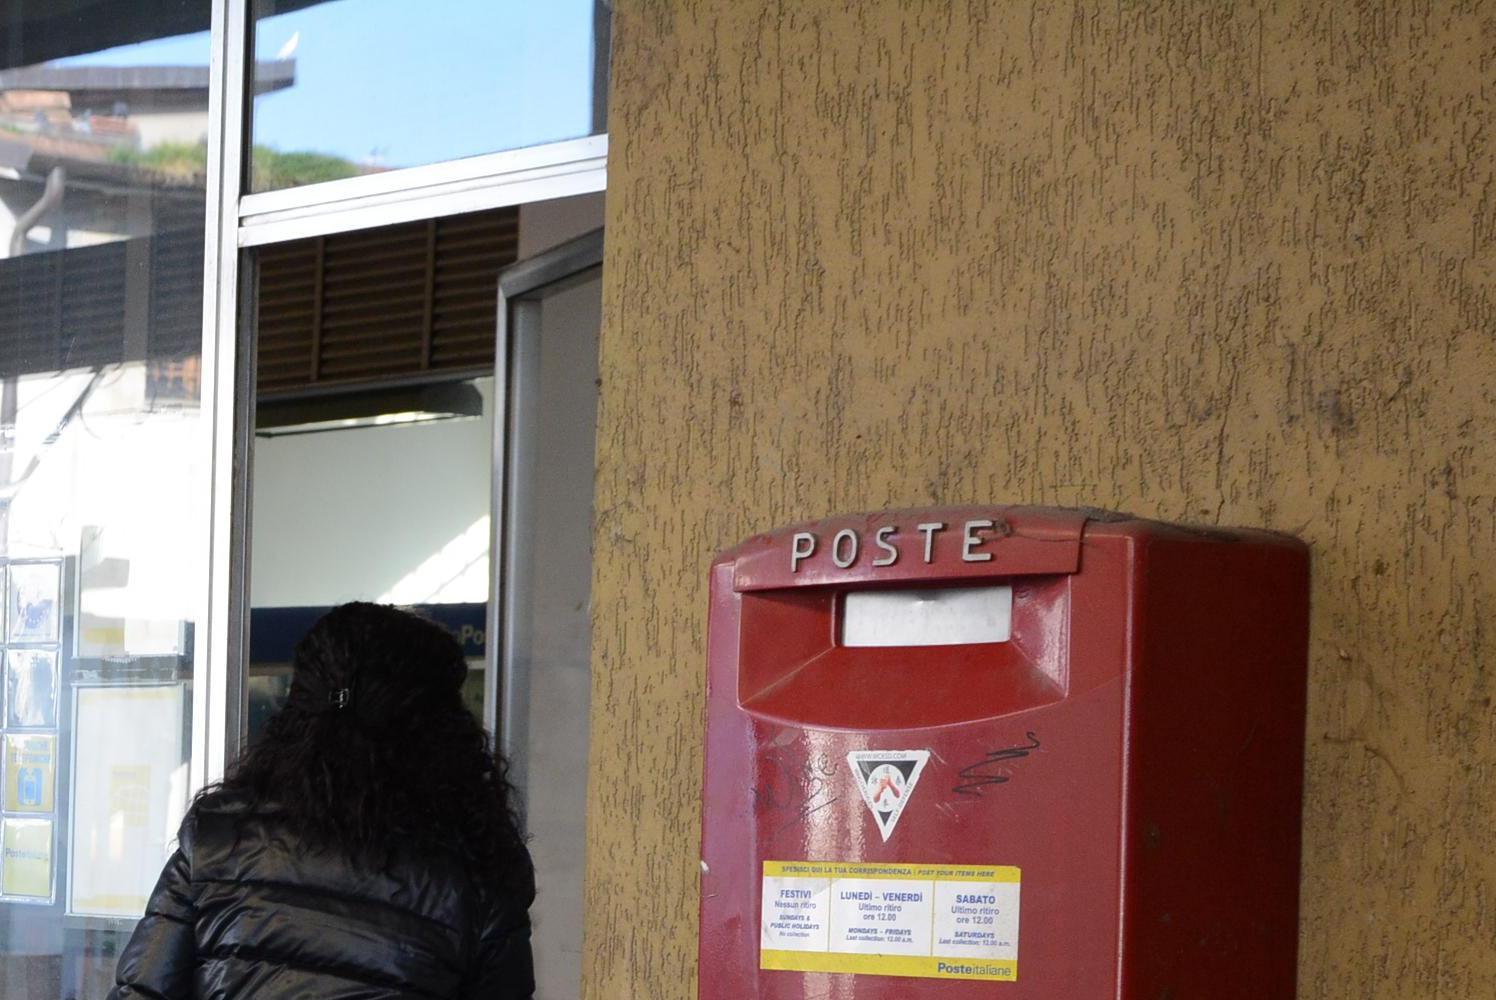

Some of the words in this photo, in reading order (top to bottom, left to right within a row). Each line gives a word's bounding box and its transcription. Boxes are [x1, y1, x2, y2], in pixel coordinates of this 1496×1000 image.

[791, 519, 993, 573] POSTE
[849, 867, 912, 875] CORRISPONDENZA
[780, 889, 811, 899] FESTIVI
[840, 889, 872, 901] LUNEDÌ
[882, 891, 923, 902] VENERDÌ
[956, 894, 996, 904] SABATO
[774, 901, 799, 909] Nessun
[800, 901, 816, 909] ritiro
[858, 903, 882, 911] Ultimo
[884, 904, 902, 912] ritiro
[951, 906, 978, 914] Ultimo
[979, 907, 999, 915] ritiro
[878, 913, 896, 921] 12.00
[972, 916, 993, 924] 12.00
[885, 928, 911, 936] FRIDAYS
[954, 931, 995, 939] SATURDAYS
